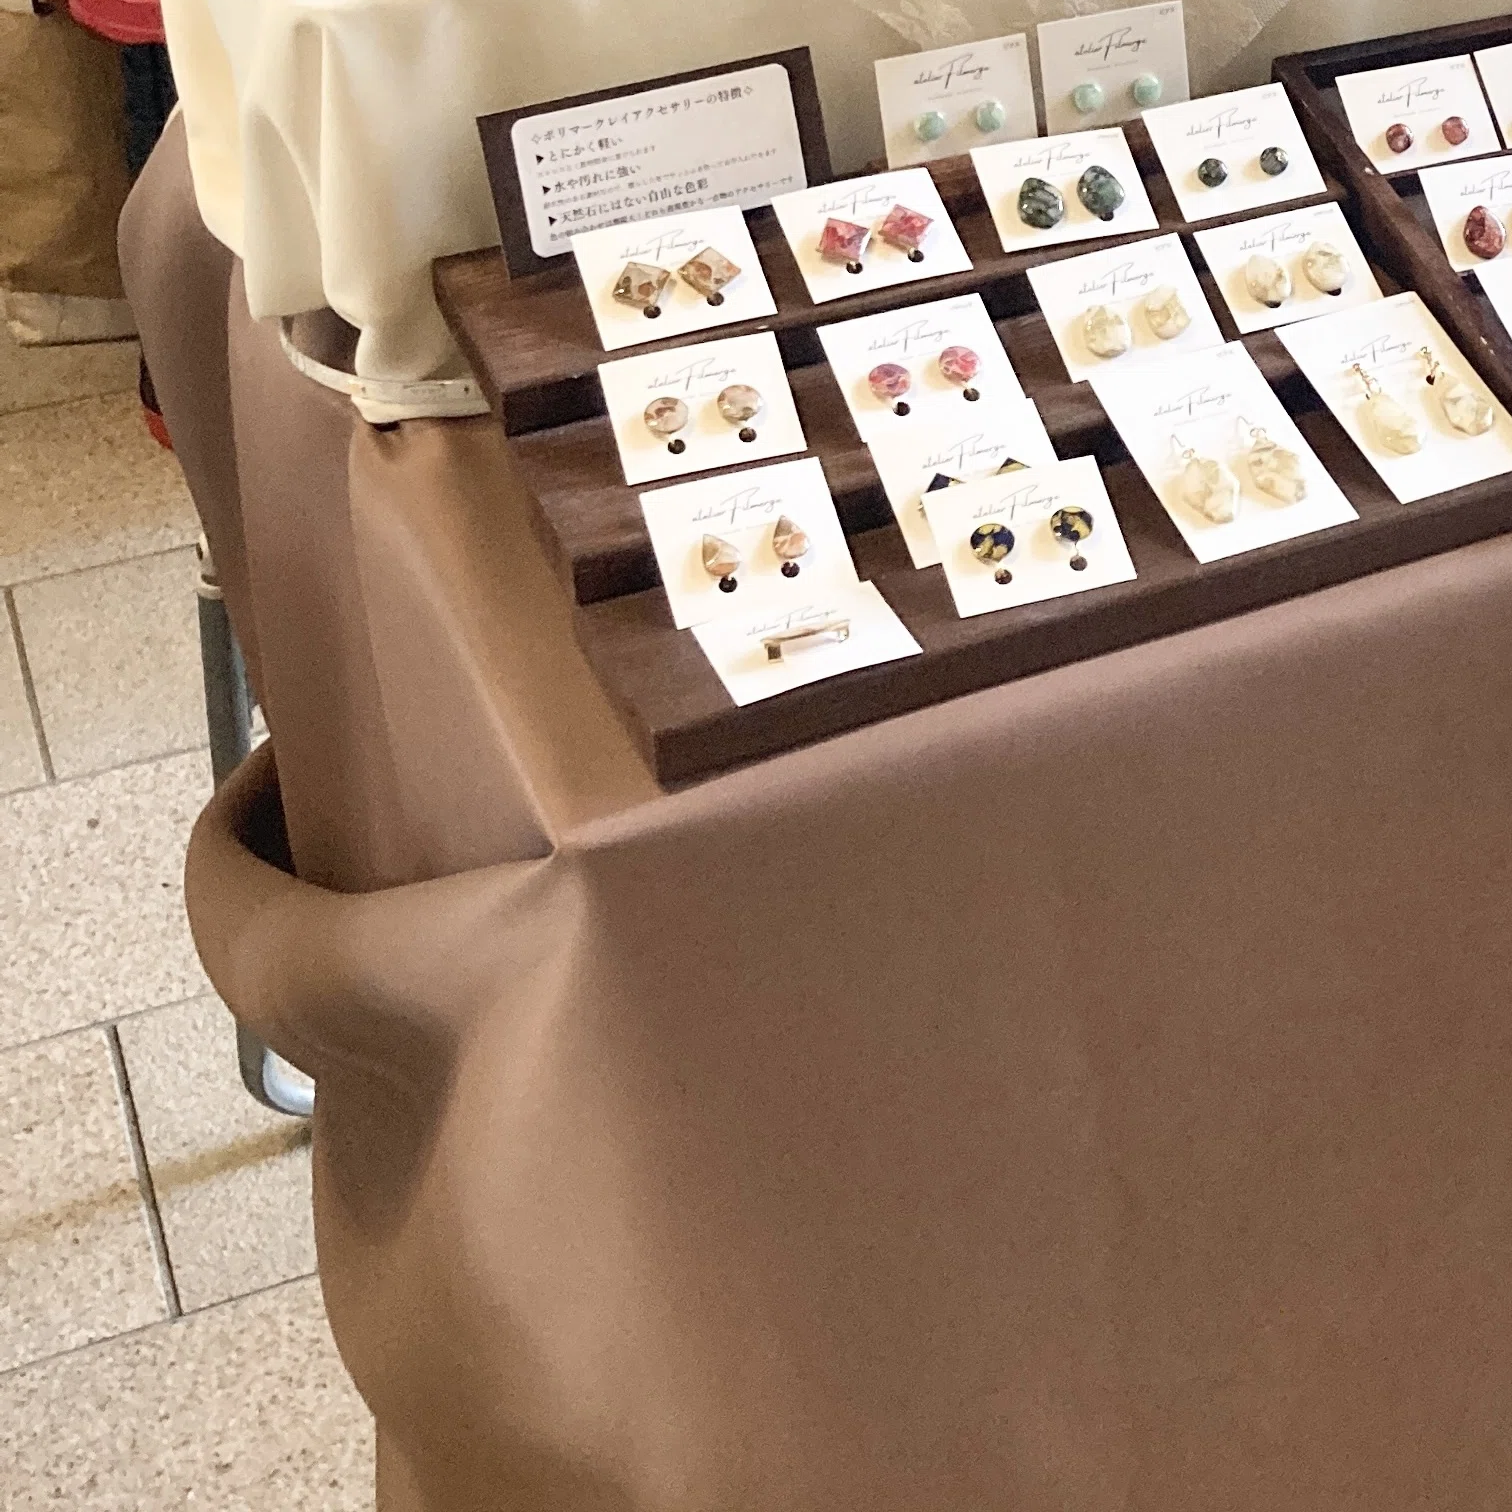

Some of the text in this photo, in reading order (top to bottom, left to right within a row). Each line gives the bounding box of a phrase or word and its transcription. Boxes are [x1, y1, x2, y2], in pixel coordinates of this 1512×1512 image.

[544, 87, 742, 140] ポリマークレイアクセサリーの特徴
[549, 138, 623, 161] とにかく軽い
[555, 166, 641, 193] 水や汚れに強い
[562, 178, 709, 224] 天然石にはない自由な色彩
